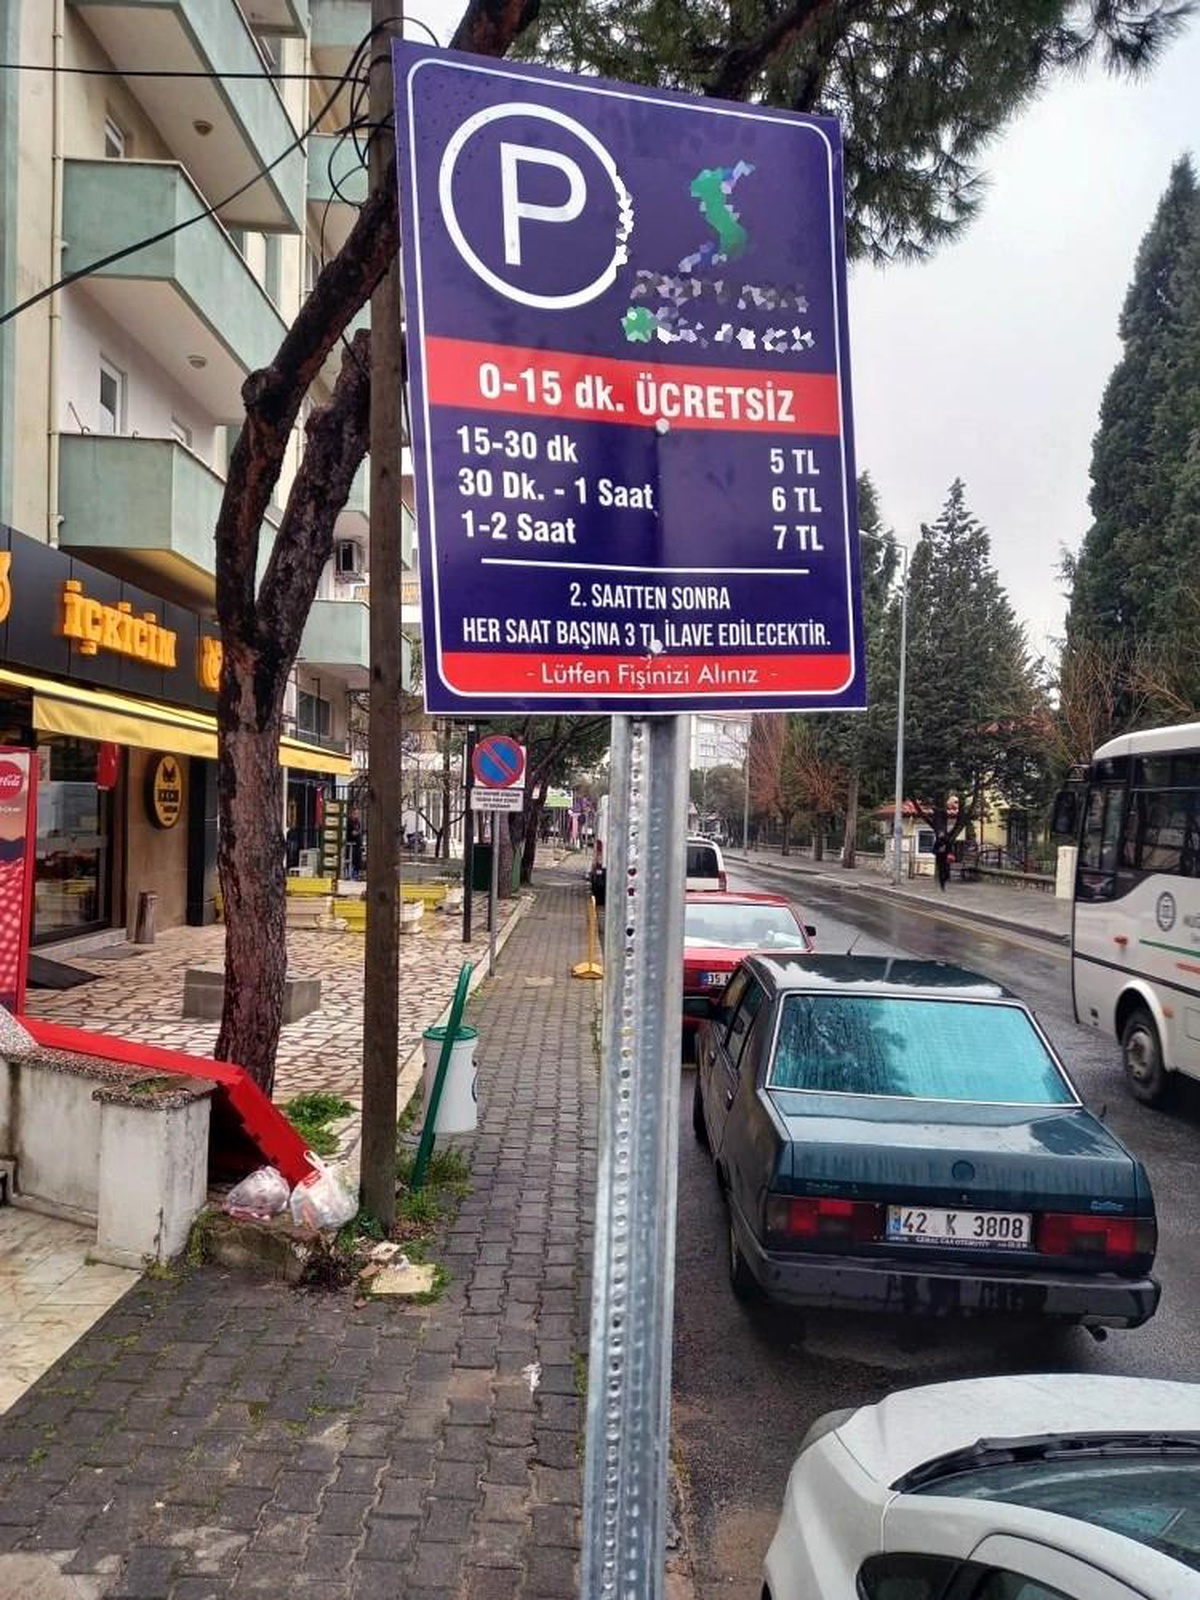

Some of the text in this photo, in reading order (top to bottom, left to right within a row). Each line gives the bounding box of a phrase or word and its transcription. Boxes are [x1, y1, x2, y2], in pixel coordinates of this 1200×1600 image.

[500, 142, 587, 265] P
[478, 362, 797, 423] 0-15 dk. ÜCRETSİZ
[456, 425, 579, 463] 15-30 dk
[771, 447, 820, 475] 5 TL
[458, 467, 493, 497] 30
[502, 471, 545, 501] Dk.
[574, 476, 587, 504] 1
[598, 478, 654, 510] Saat
[771, 486, 822, 513] 6 TL
[461, 509, 577, 544] 1-2 Saat
[773, 524, 824, 551] 7 TL
[569, 582, 731, 610] 2. SAATTEN SONRA
[463, 617, 831, 650] HER SAAT BAŞINA 3 TL İLAVE EDİLECEKTİR.
[541, 661, 610, 684] Lütfen
[618, 663, 690, 690] Fişinizi
[697, 663, 759, 685] Alınız
[903, 1211, 927, 1233] 42
[946, 1214, 957, 1236] K
[973, 1215, 1023, 1239] 3808
